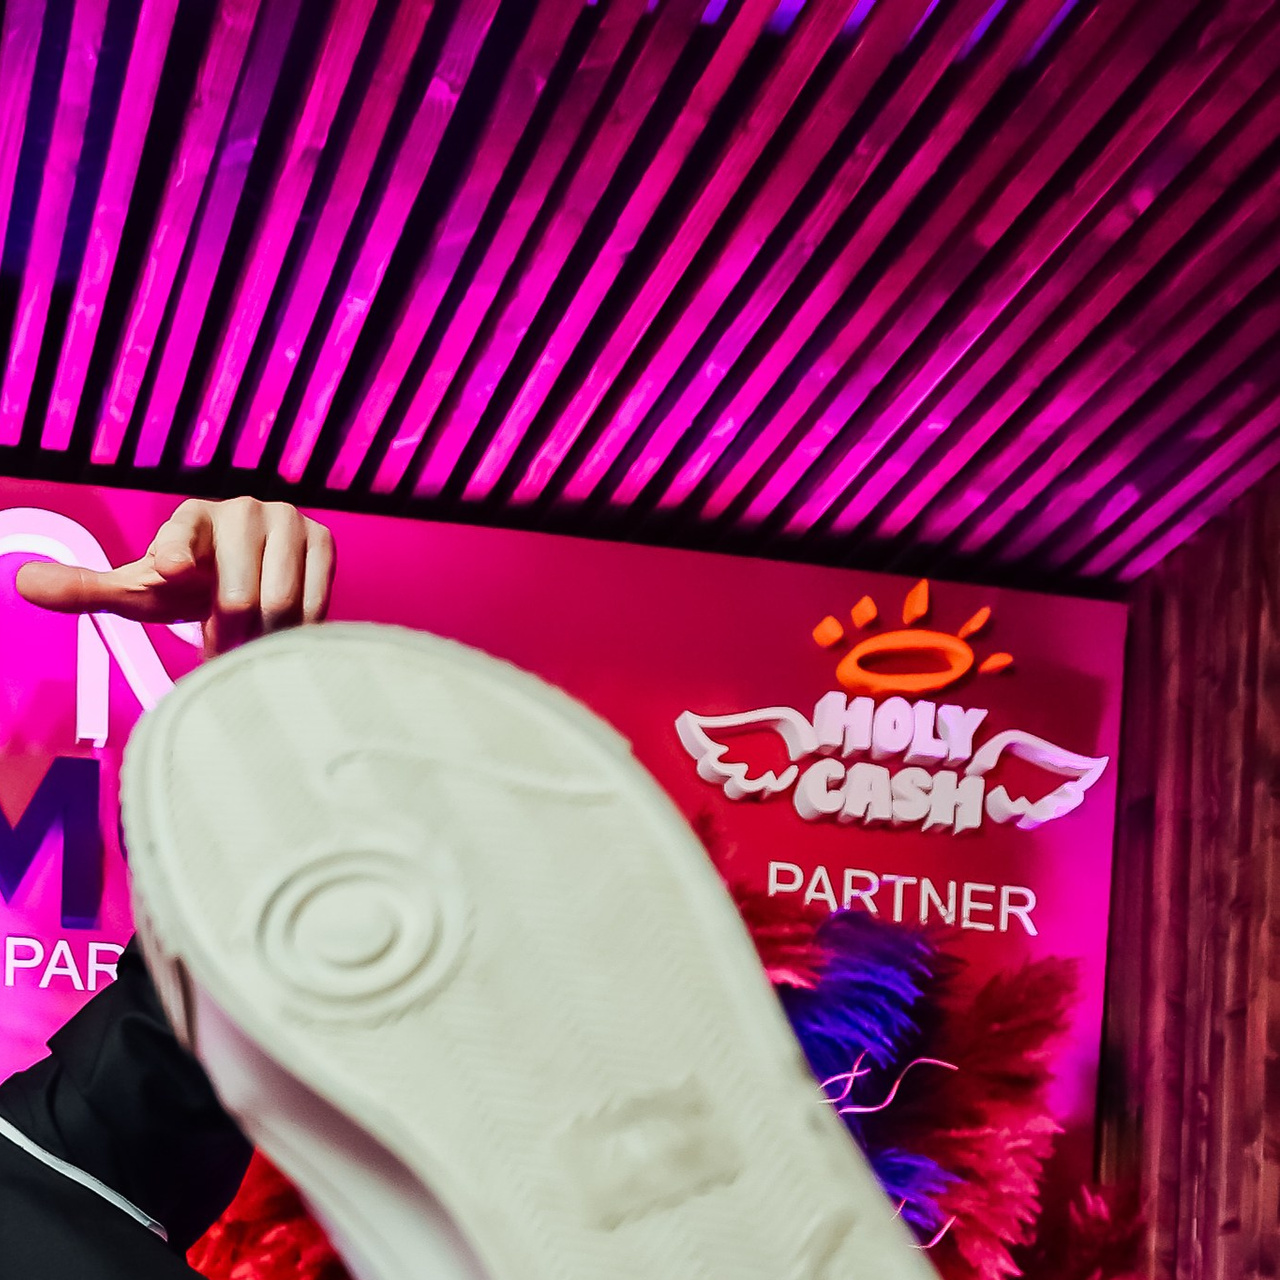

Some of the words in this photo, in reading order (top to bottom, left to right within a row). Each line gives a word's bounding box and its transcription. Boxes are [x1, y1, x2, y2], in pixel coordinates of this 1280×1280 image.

[814, 691, 988, 767] HOLY
[794, 758, 986, 835] CASH
[768, 861, 1038, 937] PARTNER
[4, 937, 126, 991] PAR
